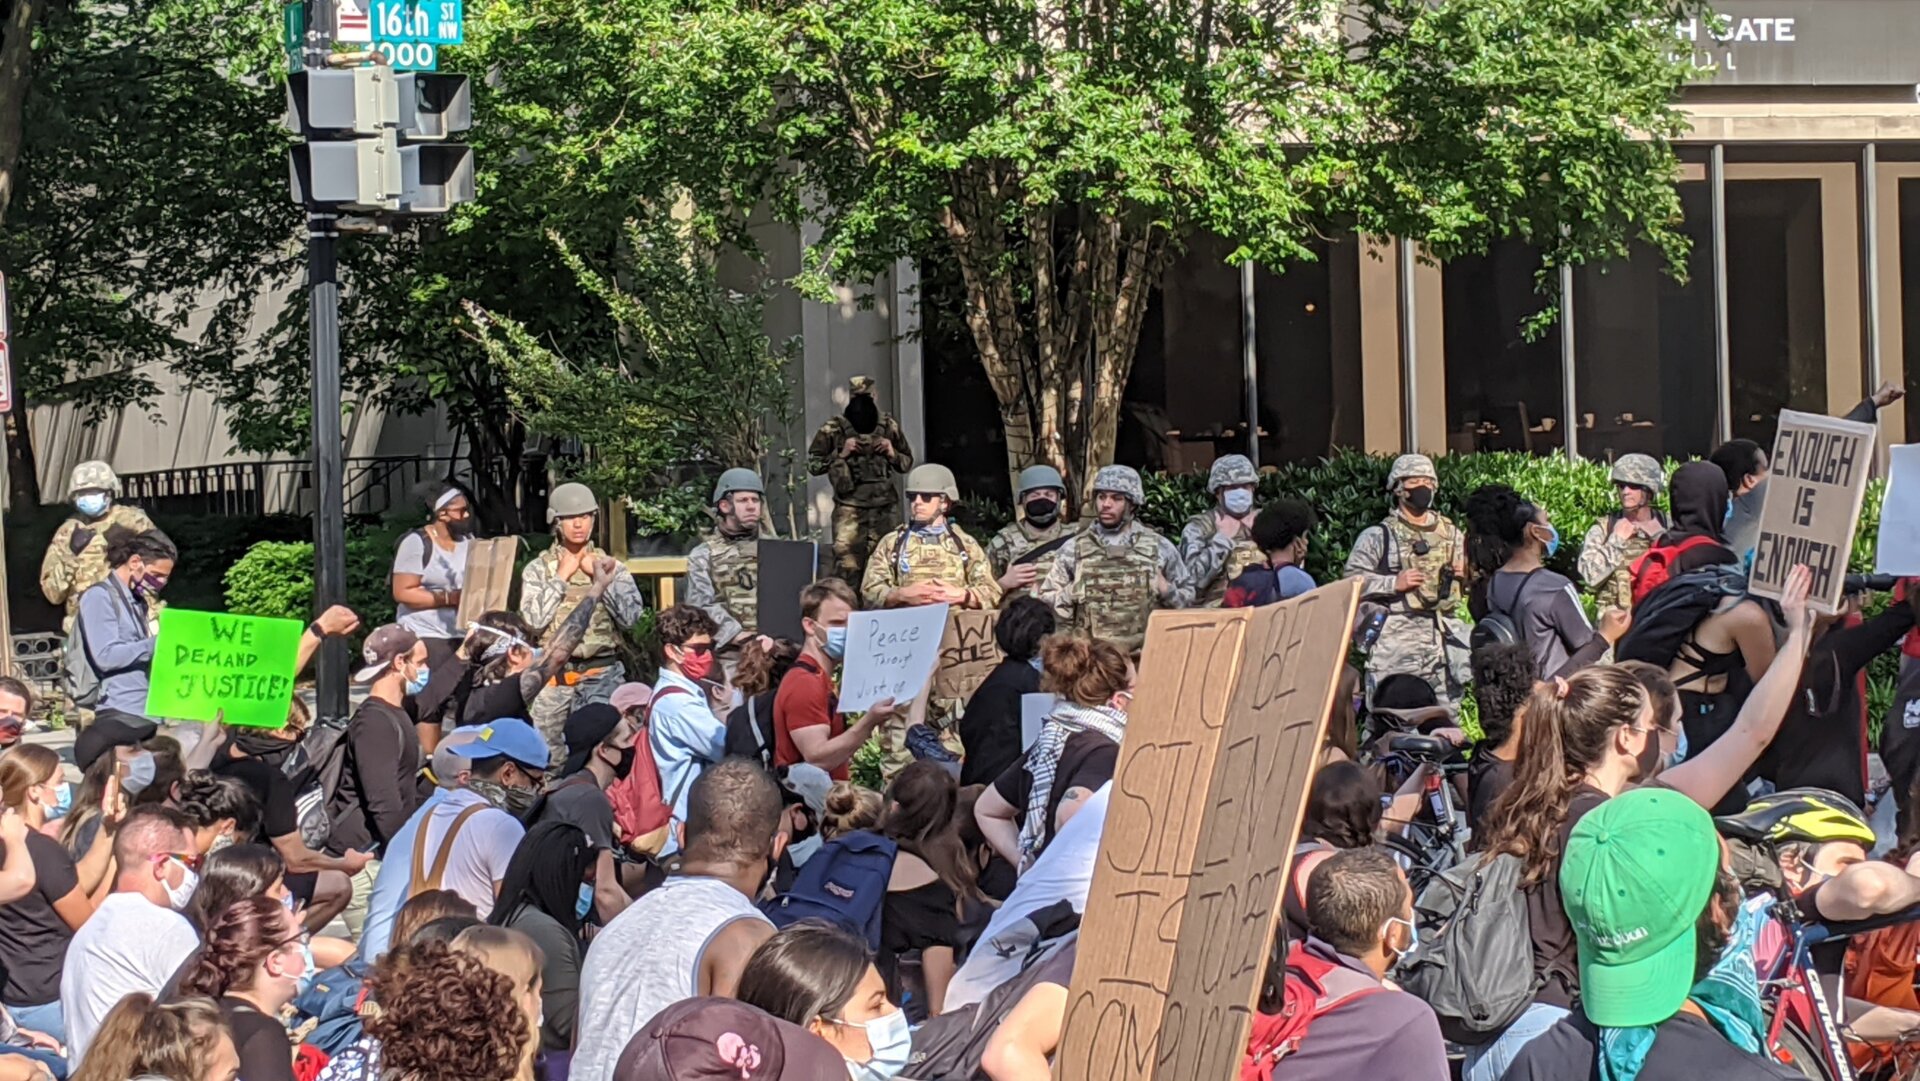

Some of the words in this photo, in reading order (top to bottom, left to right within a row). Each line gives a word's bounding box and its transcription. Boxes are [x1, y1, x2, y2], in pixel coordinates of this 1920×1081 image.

[376, 1, 429, 37] 16th
[440, 2, 455, 20] ST
[438, 21, 458, 40] NW
[1706, 14, 1796, 42] GATE
[1772, 430, 1858, 487] ENOUGH
[1792, 486, 1816, 527] IS
[209, 616, 254, 647] WE
[869, 618, 921, 651] Peace
[174, 644, 258, 668] DEMAND
[1164, 616, 1248, 730] TO
[1252, 595, 1319, 711] BE
[176, 673, 290, 702] JUSTICE!
[1106, 720, 1313, 879] SILENT
